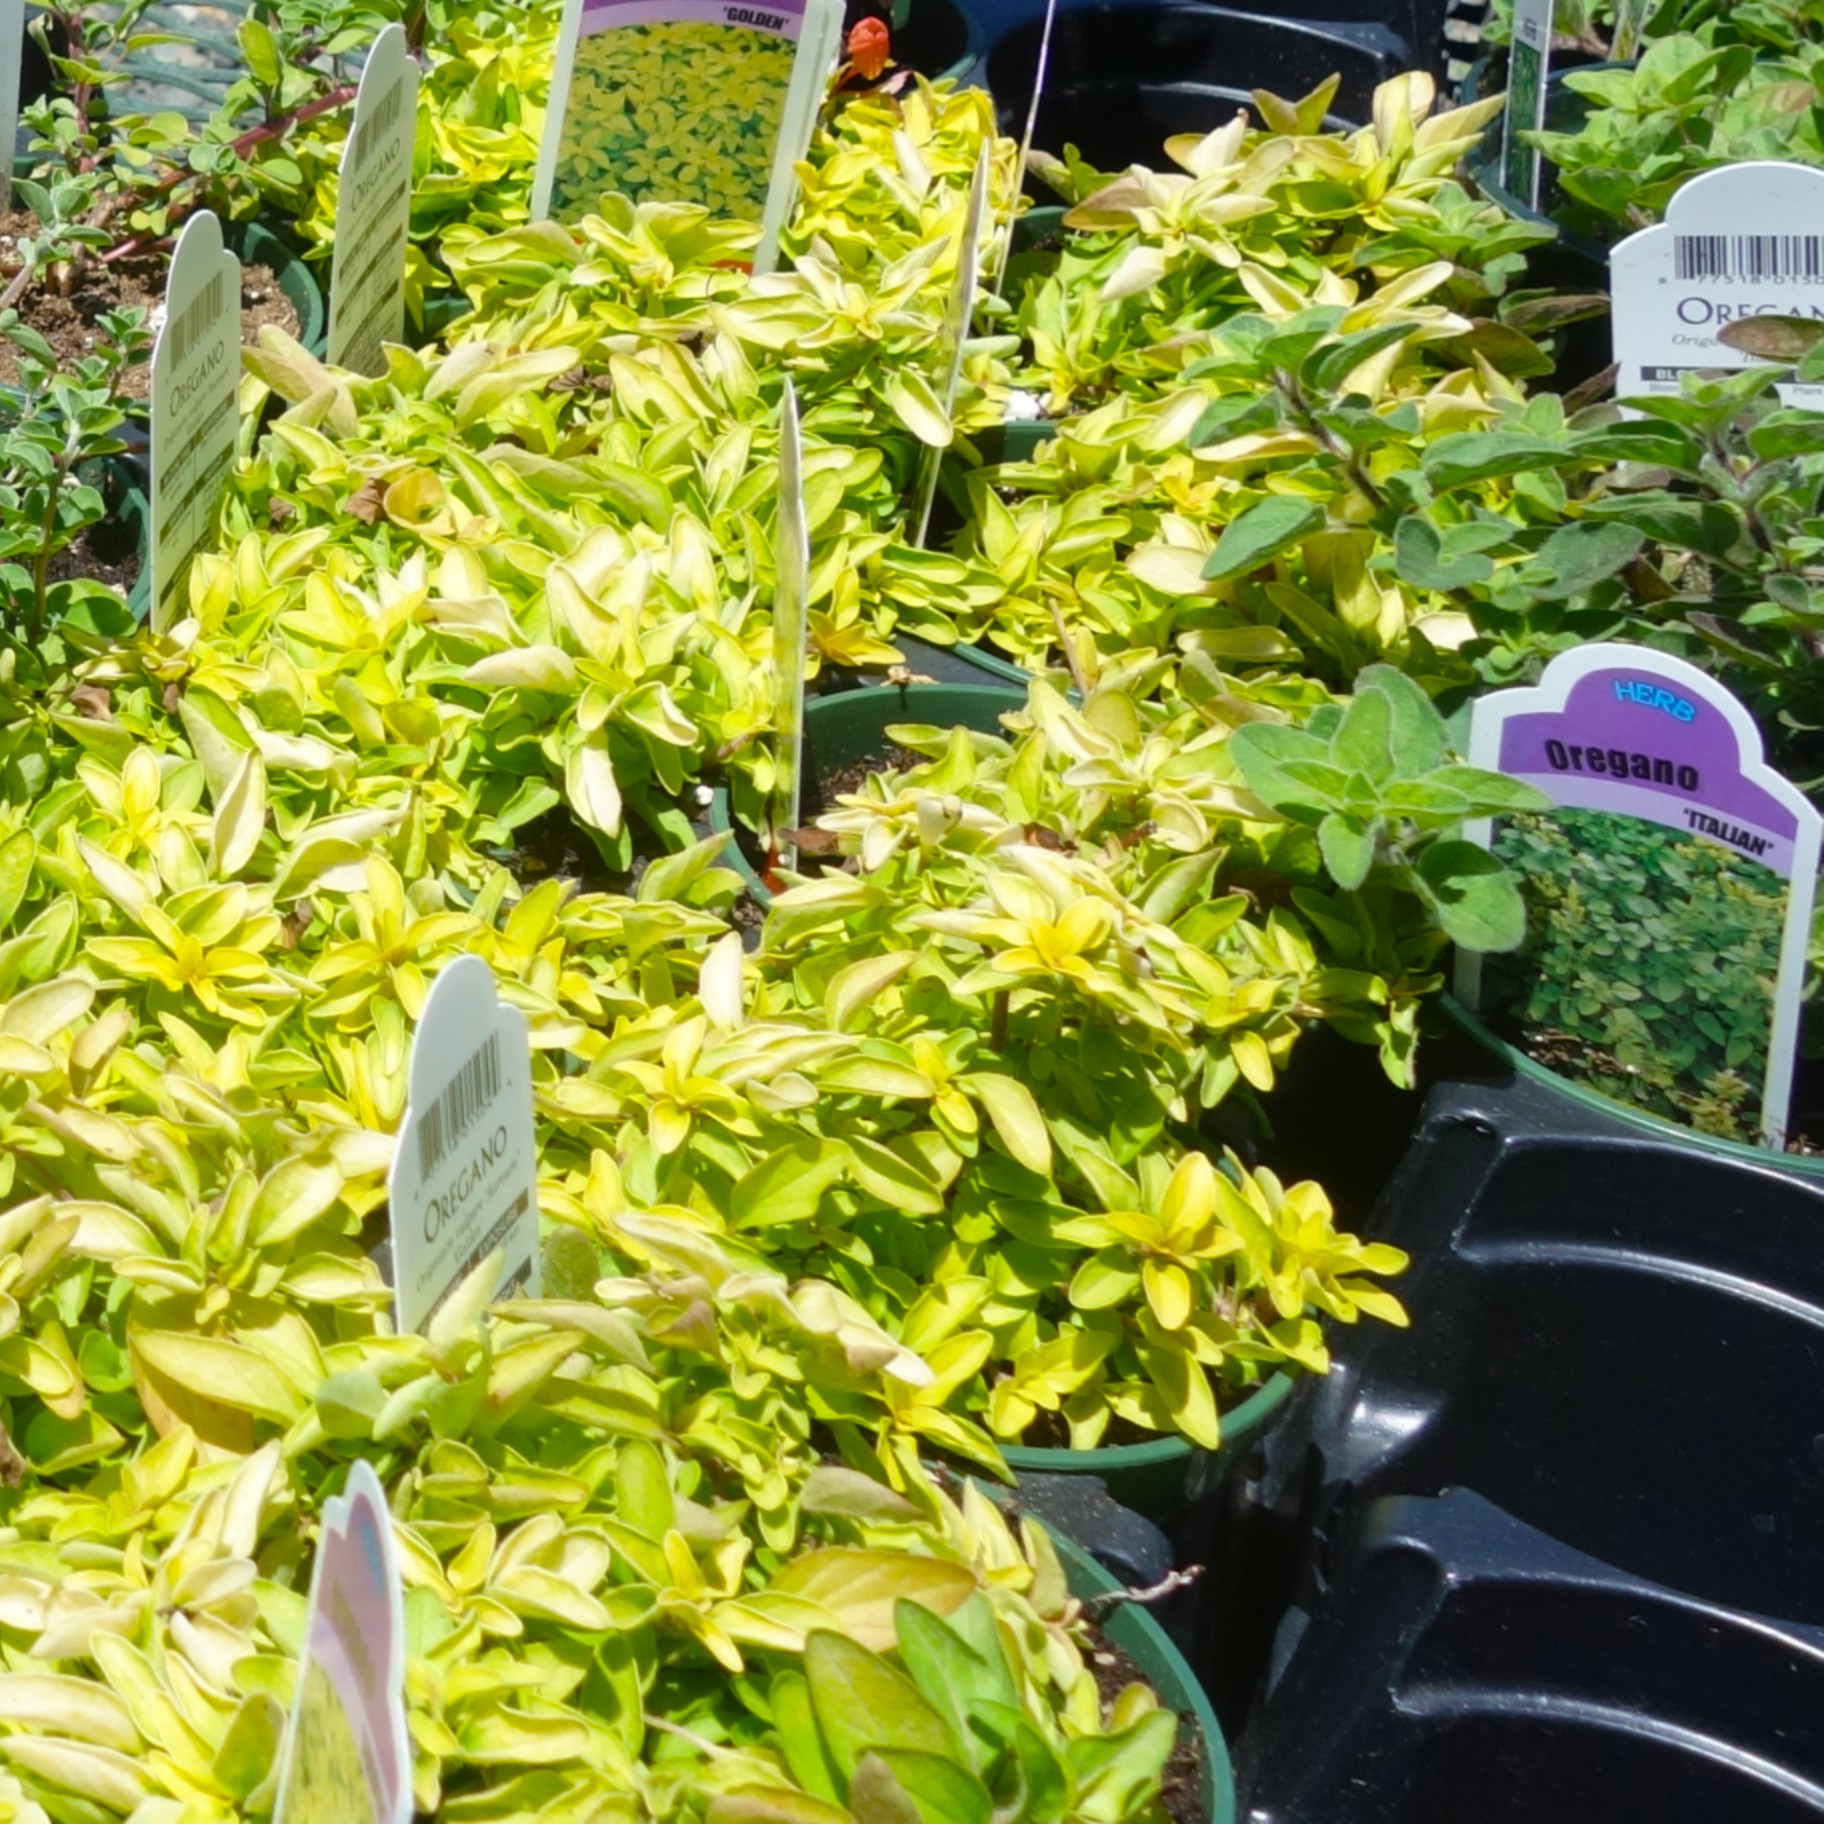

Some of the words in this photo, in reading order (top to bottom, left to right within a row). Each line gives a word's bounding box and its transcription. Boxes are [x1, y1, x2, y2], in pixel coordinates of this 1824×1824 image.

[351, 137, 402, 213] OREGANO
[169, 338, 226, 419] OREGANO
[1613, 679, 1696, 723] HERB
[1544, 738, 1700, 792] Oregano
[422, 1124, 508, 1244] OREGANO
